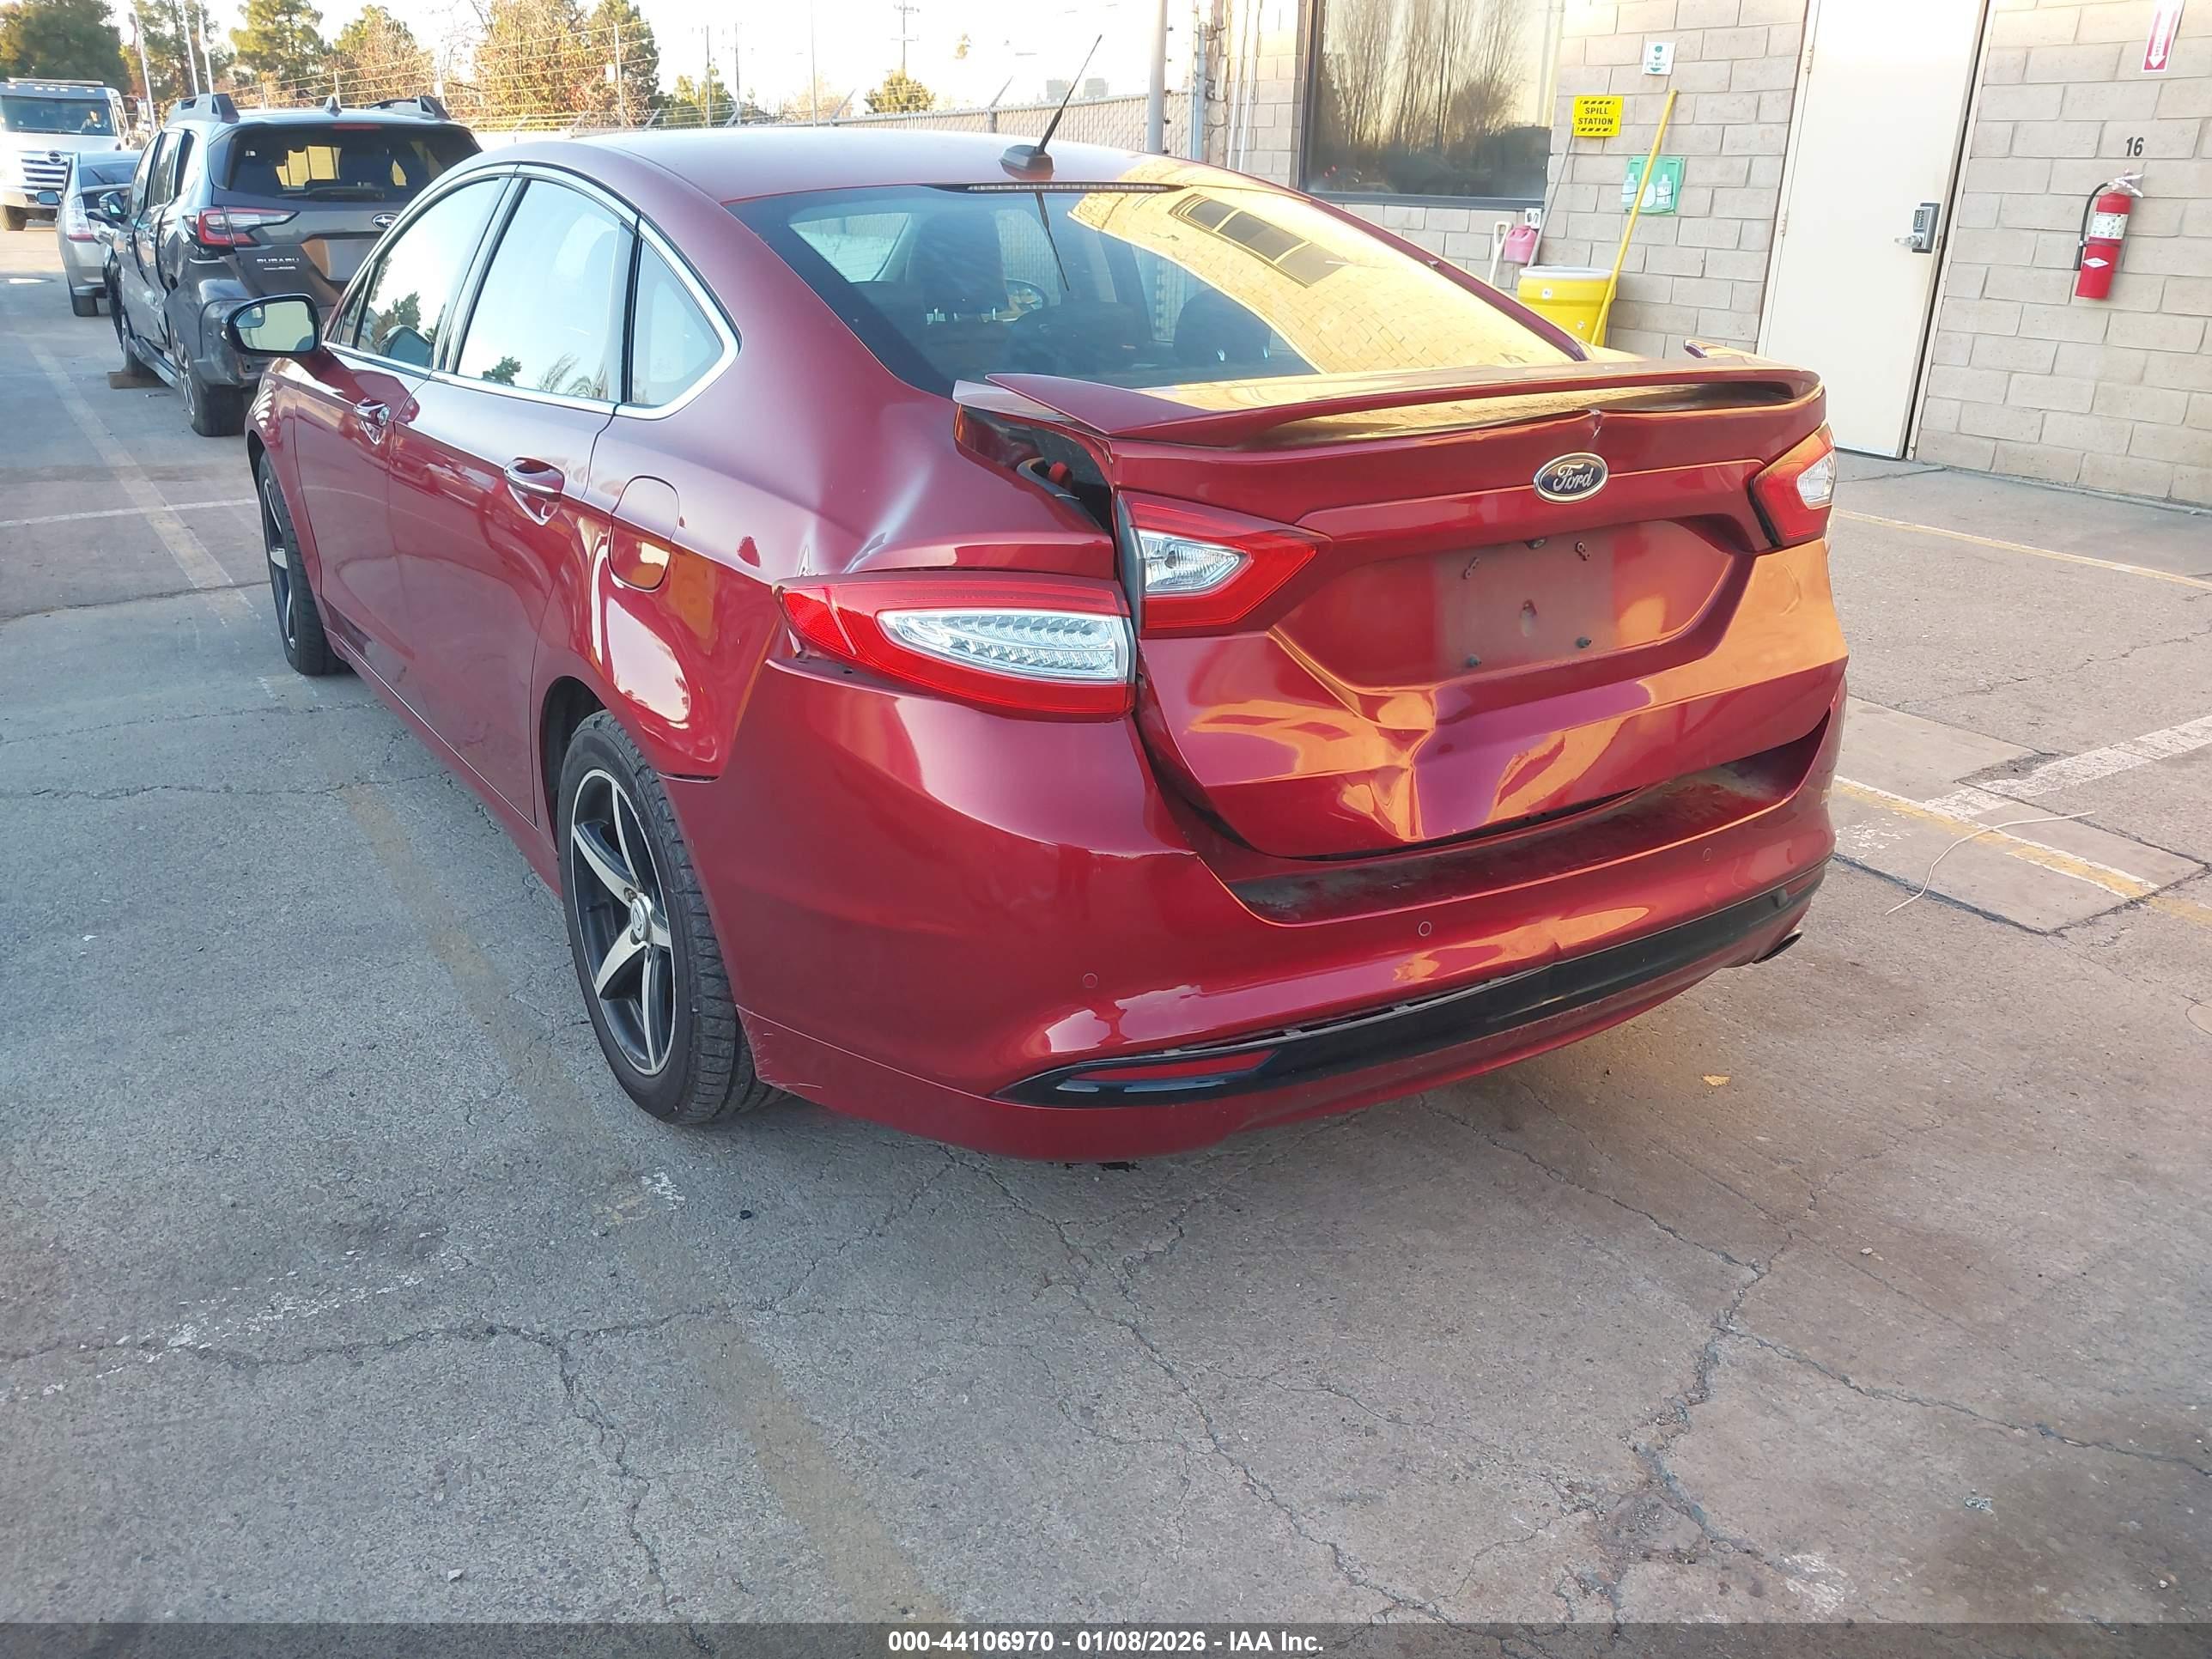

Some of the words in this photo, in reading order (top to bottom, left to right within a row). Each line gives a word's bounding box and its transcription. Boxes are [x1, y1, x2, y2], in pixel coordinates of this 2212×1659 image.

[1584, 106, 1608, 115] SPILL
[1577, 117, 1613, 125] STATION
[2125, 137, 2144, 157] 16
[1553, 463, 1595, 492] Ford
